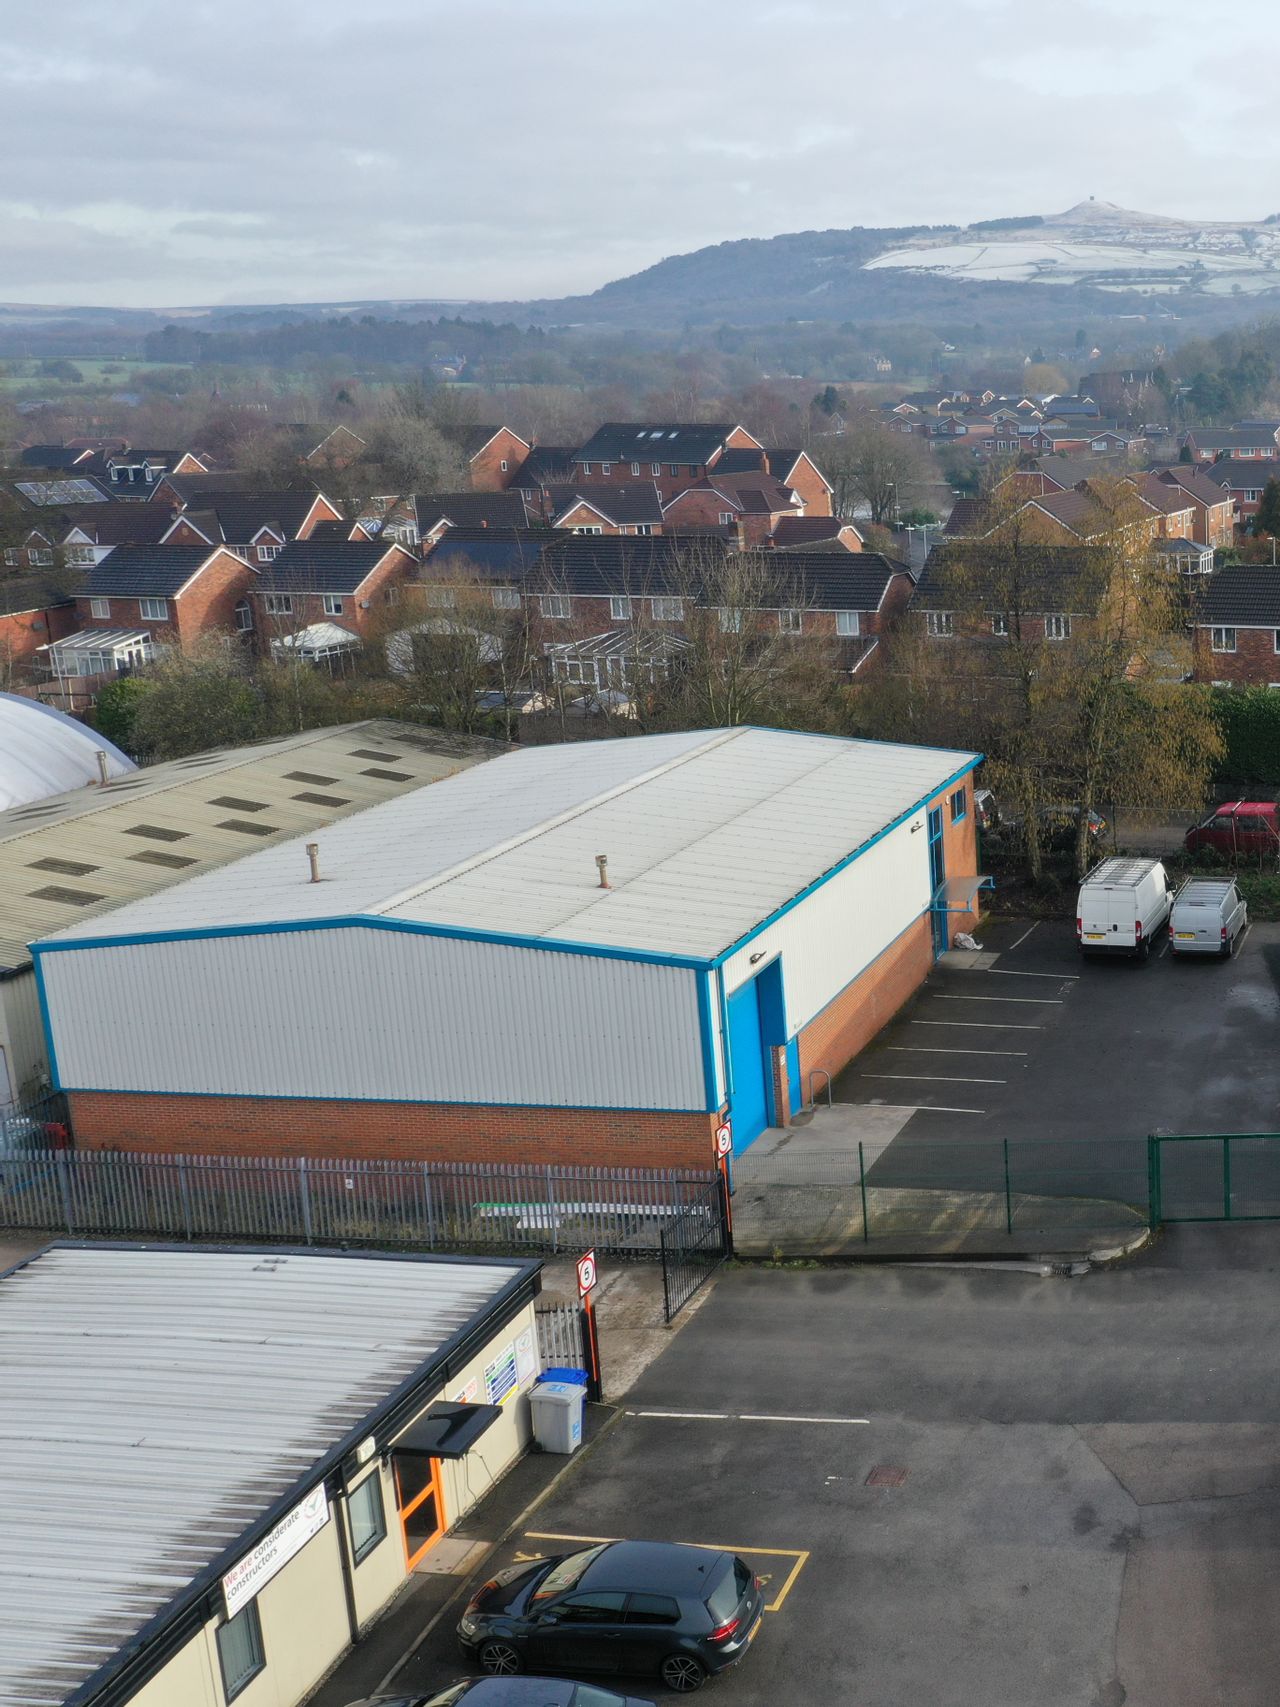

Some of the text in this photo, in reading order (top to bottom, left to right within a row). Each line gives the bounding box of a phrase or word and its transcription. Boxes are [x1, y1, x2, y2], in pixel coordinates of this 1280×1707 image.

[721, 1134, 727, 1146] 5
[583, 1266, 590, 1281] 5
[224, 1511, 300, 1588] We are considerate
[226, 1547, 278, 1601] constructors
